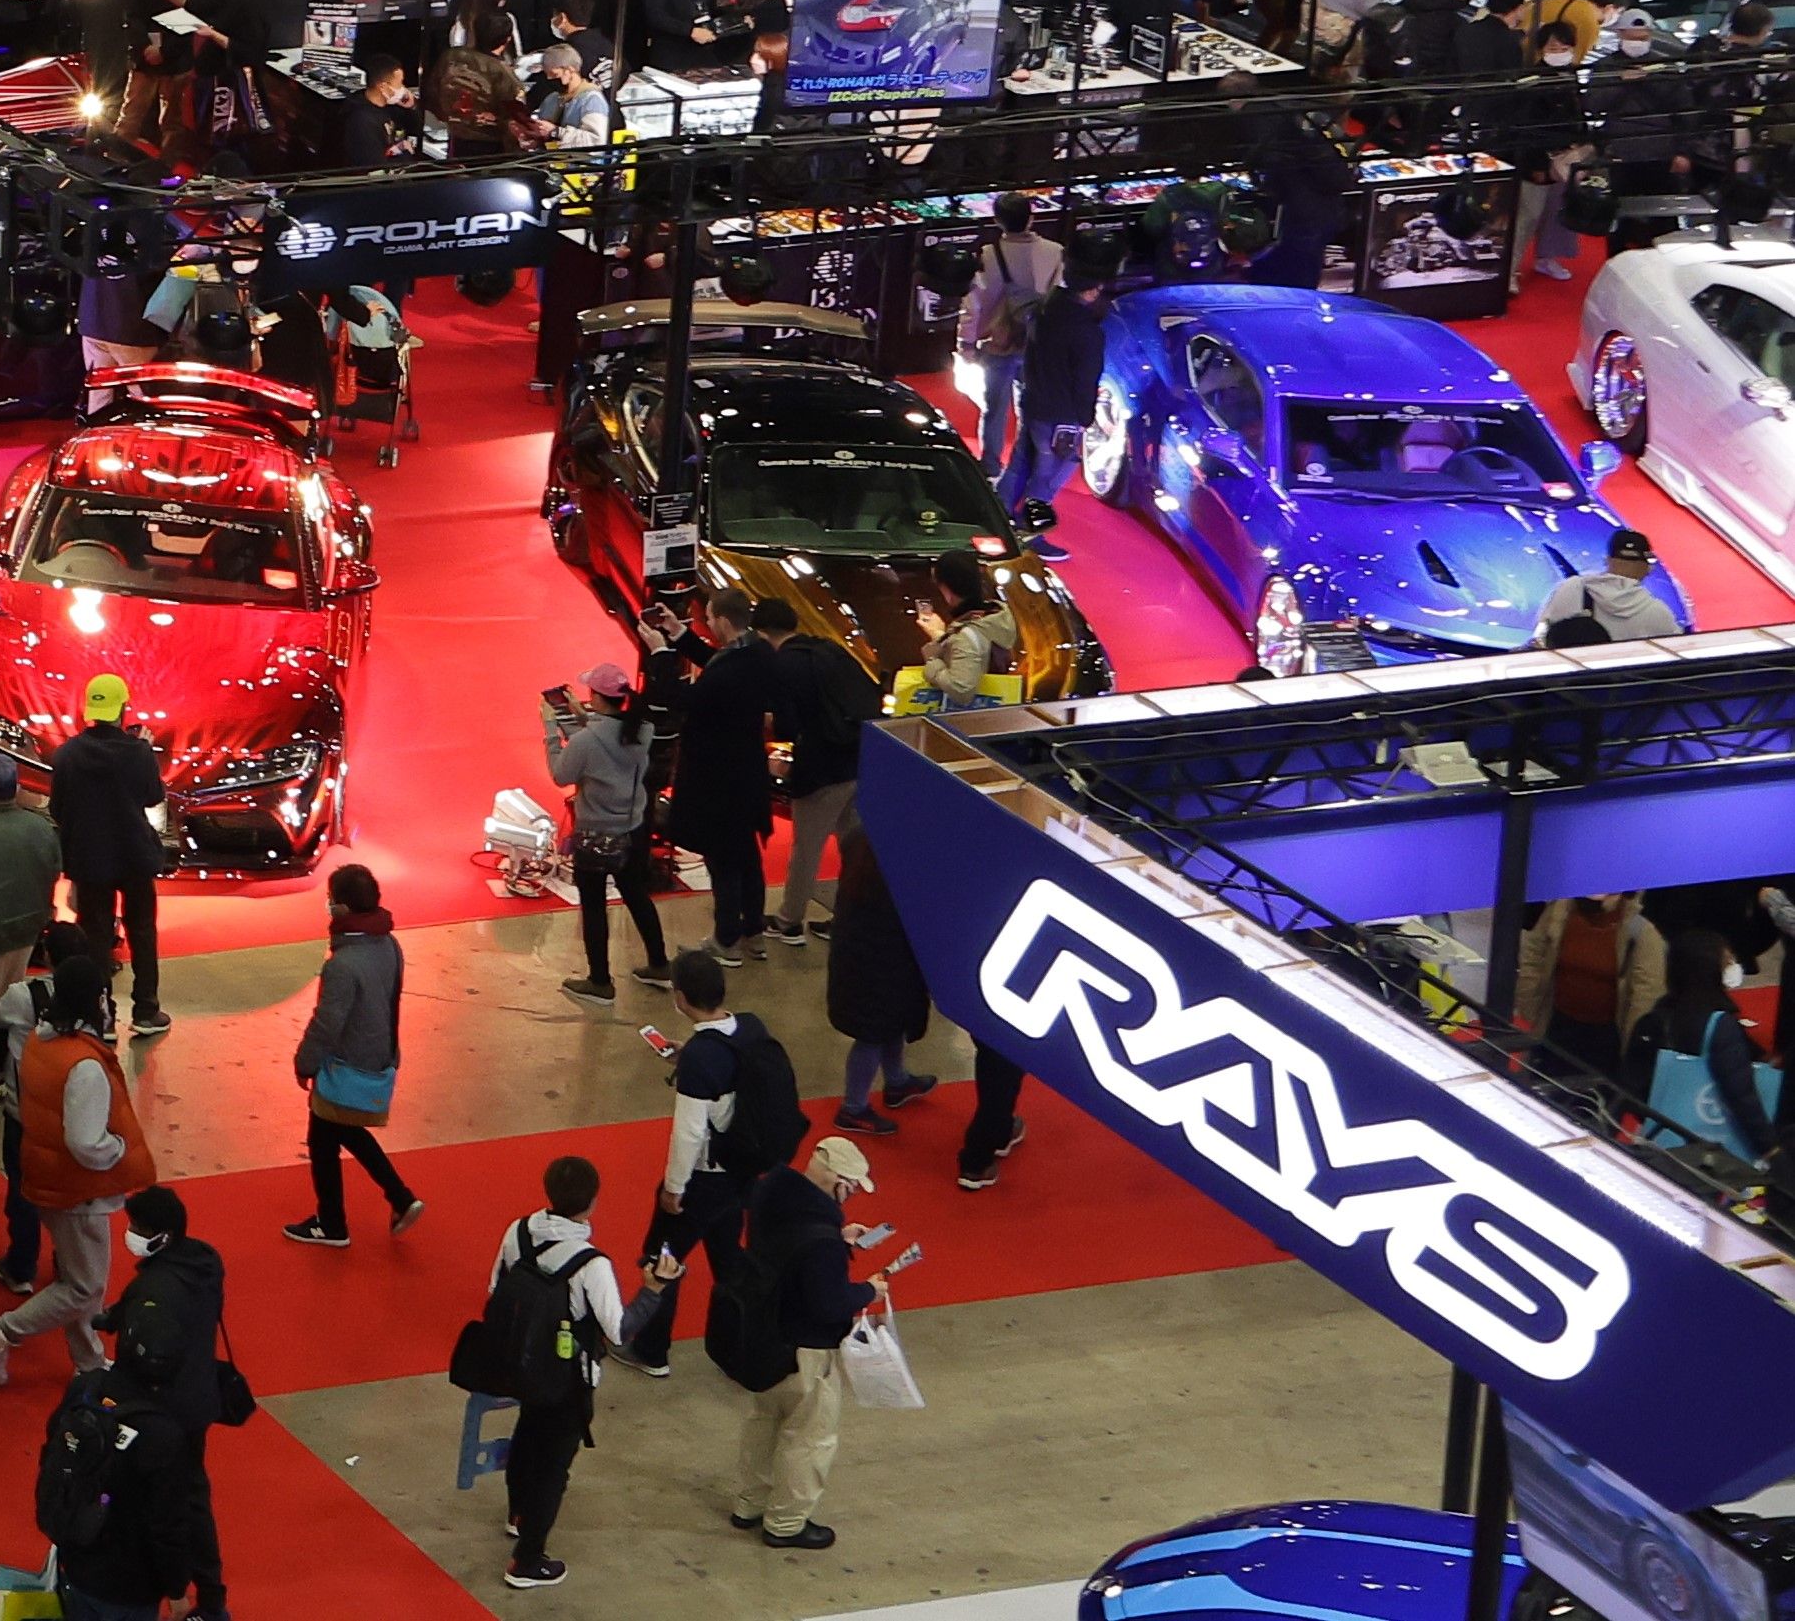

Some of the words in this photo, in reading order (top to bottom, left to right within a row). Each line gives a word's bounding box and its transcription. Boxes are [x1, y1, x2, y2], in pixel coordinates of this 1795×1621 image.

[343, 209, 551, 249] ROHAN
[383, 244, 425, 257] IZAWA
[427, 240, 457, 252] ART
[457, 234, 511, 249] DESIGN
[984, 882, 1625, 1377] RAYS
